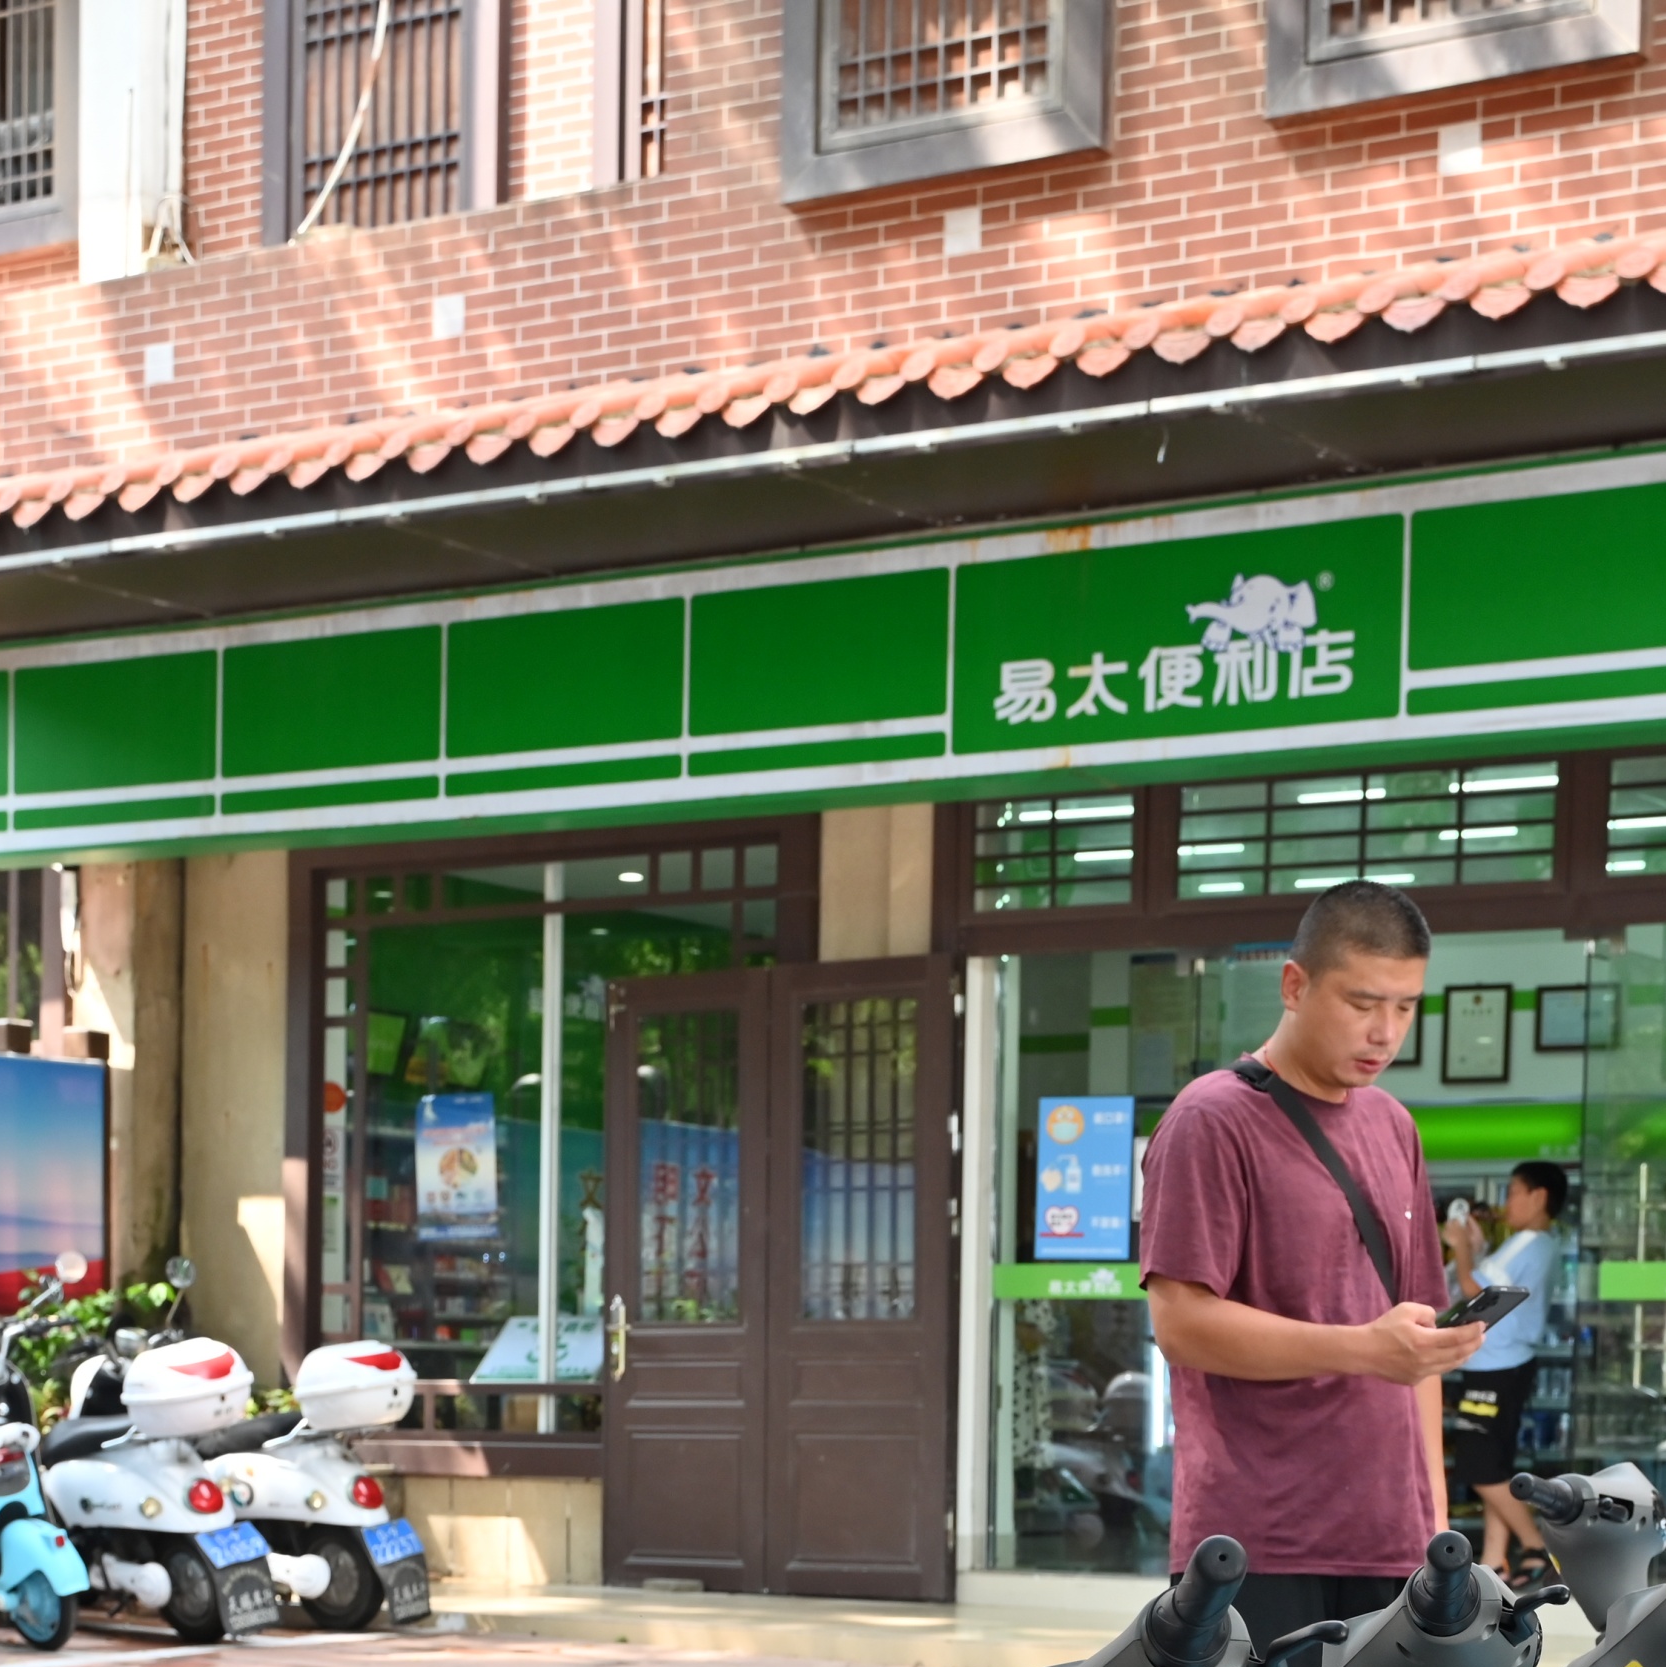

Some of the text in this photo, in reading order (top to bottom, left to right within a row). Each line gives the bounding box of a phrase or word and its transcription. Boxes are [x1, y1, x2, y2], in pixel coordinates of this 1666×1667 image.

[994, 630, 1354, 725] 易太便利店
